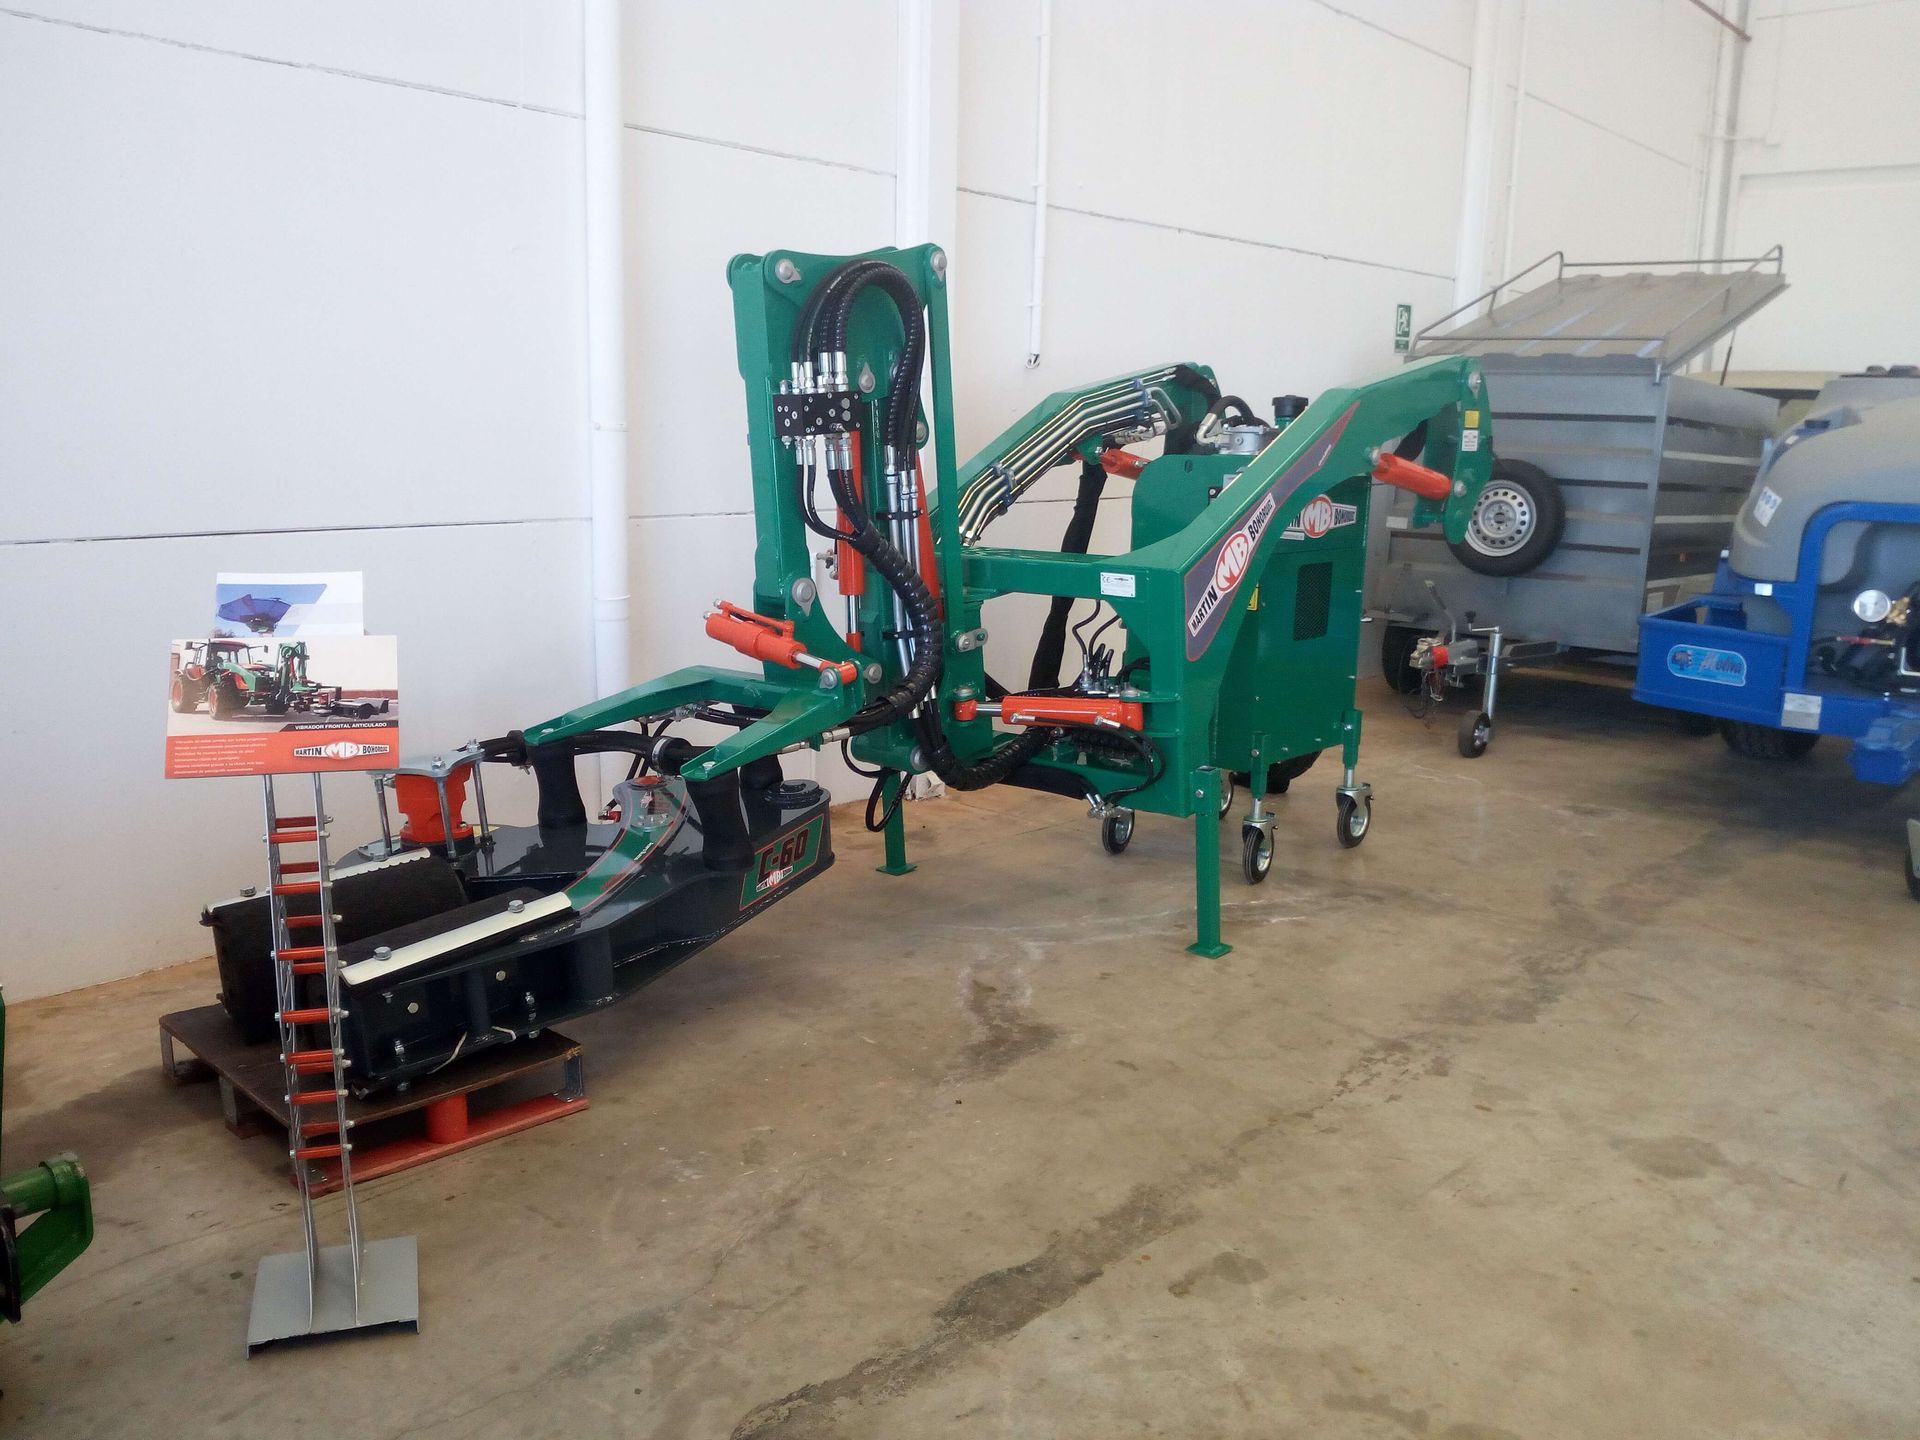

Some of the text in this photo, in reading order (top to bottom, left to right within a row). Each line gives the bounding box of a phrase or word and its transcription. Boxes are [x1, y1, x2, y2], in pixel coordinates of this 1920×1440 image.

[1303, 500, 1332, 534] MB
[1191, 584, 1218, 631] MARTIN
[1216, 536, 1248, 592] MB
[351, 721, 388, 729] ARTICULADO
[295, 746, 323, 756] MARTIN
[326, 741, 359, 758] MB
